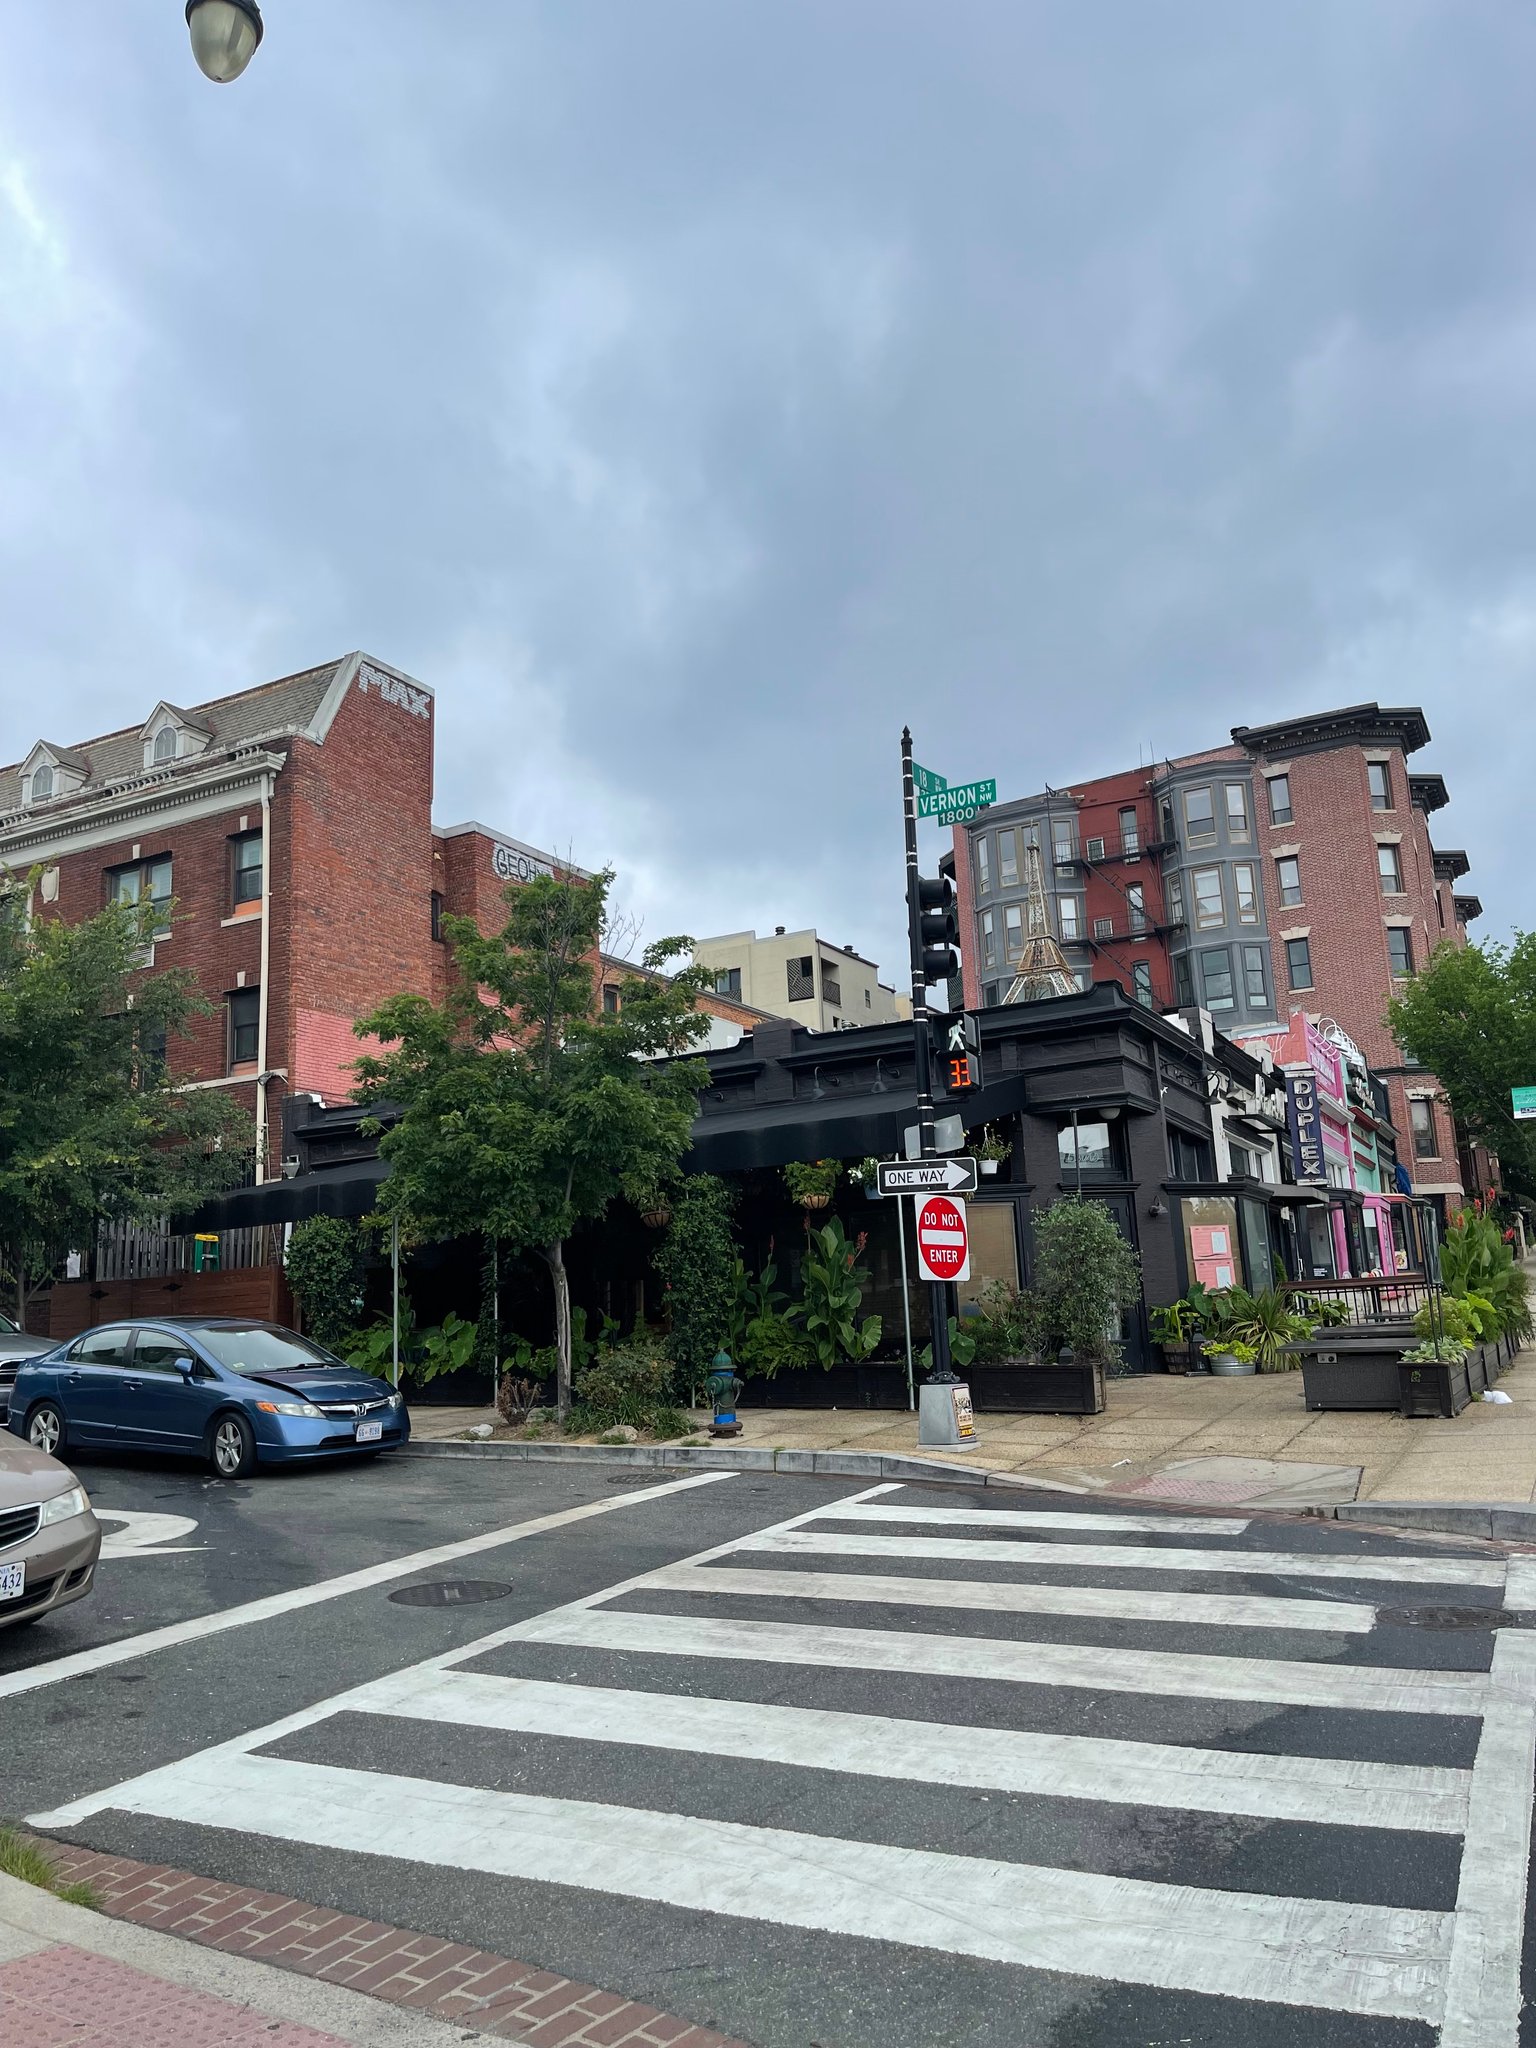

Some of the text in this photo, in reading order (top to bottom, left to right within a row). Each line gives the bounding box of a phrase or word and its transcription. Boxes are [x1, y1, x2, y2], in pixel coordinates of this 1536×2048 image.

[920, 783, 992, 814] VERNON ST
[980, 792, 992, 802] NW
[940, 806, 974, 825] 1800
[950, 1059, 972, 1087] 33
[1293, 1080, 1321, 1175] DUPLEX
[888, 1170, 945, 1185] ONE WAY
[924, 1212, 959, 1227] DO NOT
[930, 1249, 959, 1263] ENTER
